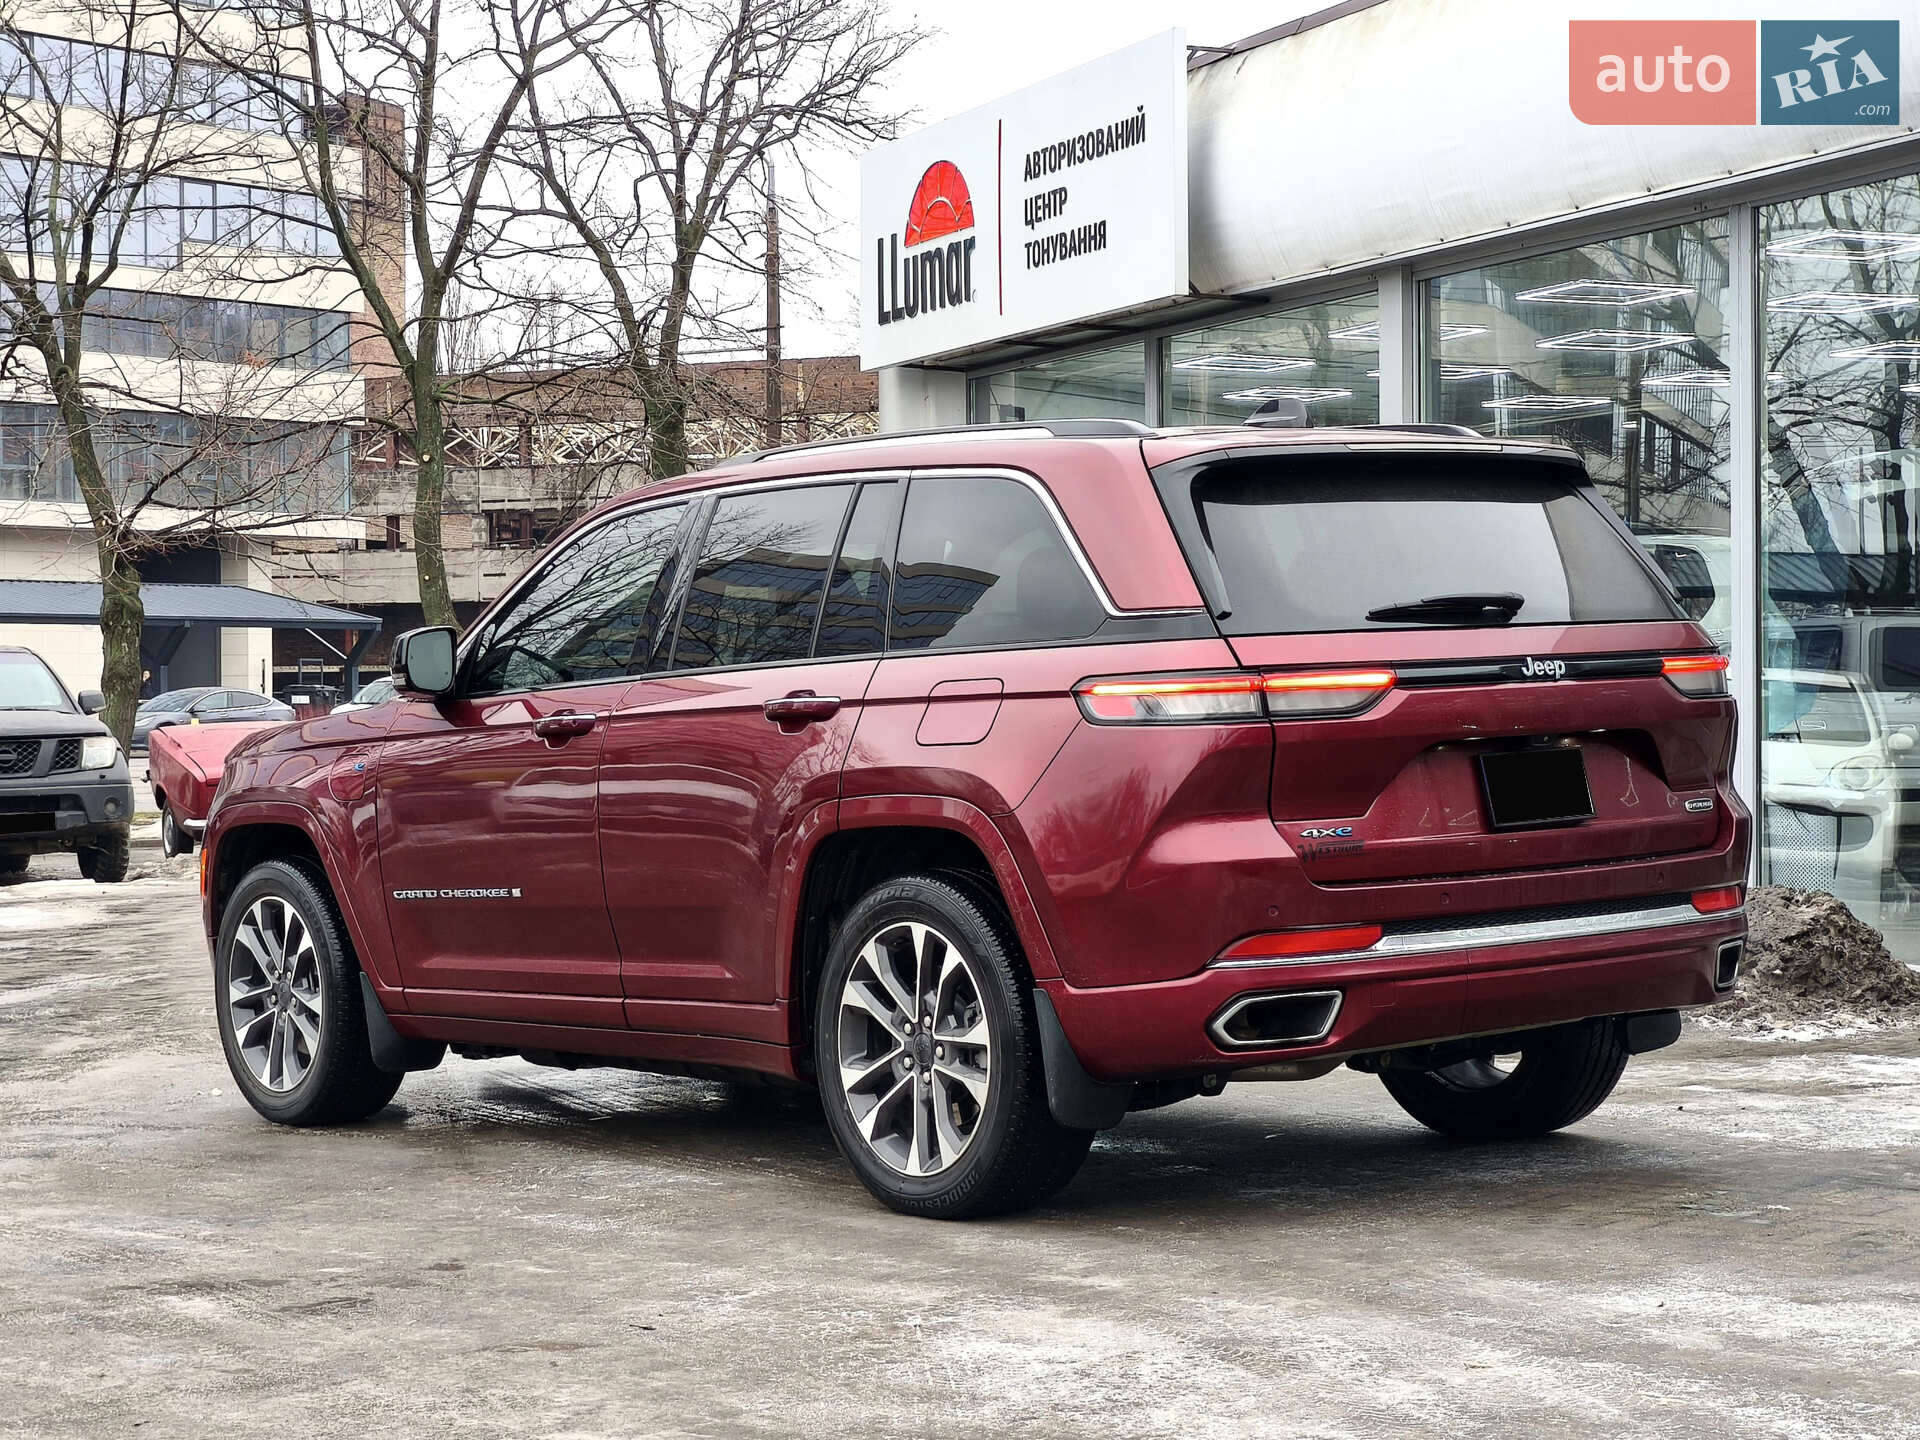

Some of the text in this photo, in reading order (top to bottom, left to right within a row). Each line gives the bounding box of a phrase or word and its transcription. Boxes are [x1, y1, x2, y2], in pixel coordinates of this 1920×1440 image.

[1023, 105, 1146, 182] АВТОРИЗОВАНИЙ
[1024, 187, 1068, 230] ЦЕНТР
[1024, 220, 1107, 269] ТОНУВАННЯ
[878, 233, 976, 326] LLumar
[1521, 656, 1566, 680] Jeep
[393, 888, 510, 899] GRAND CHEROKEE
[896, 1169, 979, 1209] BRIDGESTO
